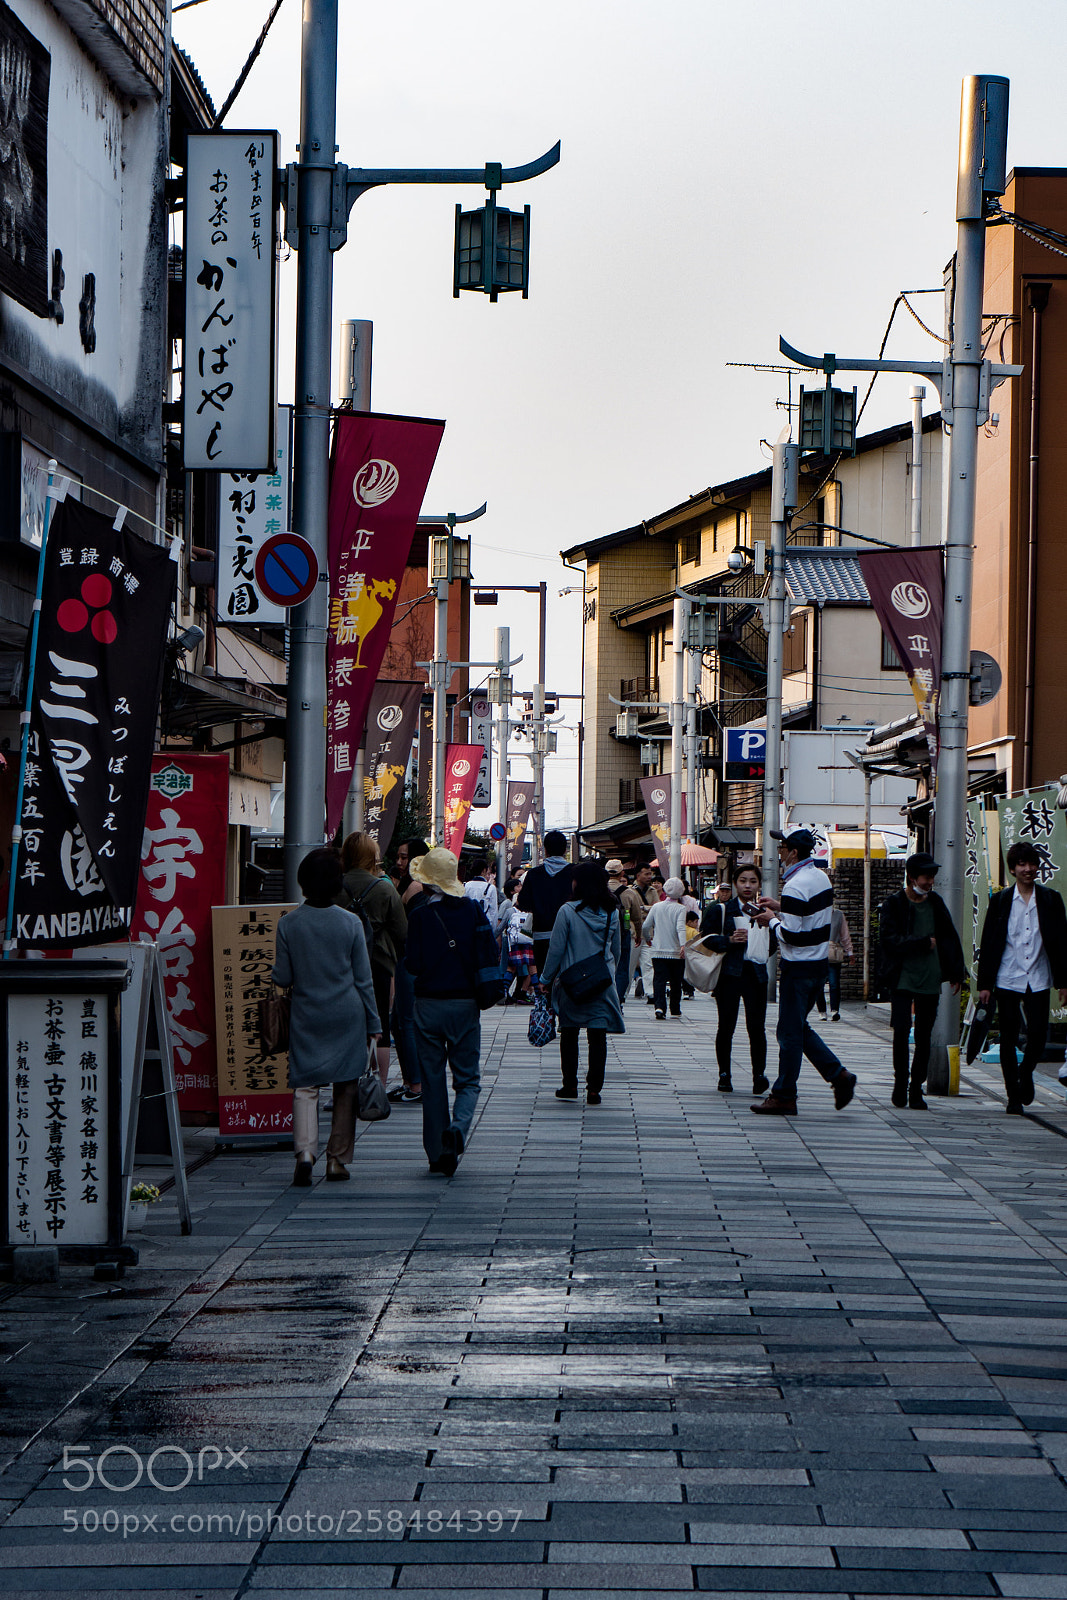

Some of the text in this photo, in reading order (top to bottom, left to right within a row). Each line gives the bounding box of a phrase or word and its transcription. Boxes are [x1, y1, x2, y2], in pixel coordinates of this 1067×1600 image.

[196, 168, 238, 461] お茶の かんばやし
[59, 547, 140, 595] 登録商標
[333, 529, 375, 774] 平等院表参道
[20, 730, 46, 886] 創業五百年
[98, 696, 132, 858] みつぼしえん
[153, 773, 191, 789] 宇治茶
[737, 731, 766, 760] P
[16, 1040, 32, 1239] お気軽にお入り下さいませ。
[44, 1074, 68, 1240] 古文書等展示中
[79, 998, 99, 1204] 豊臣 徳川家各諸大名
